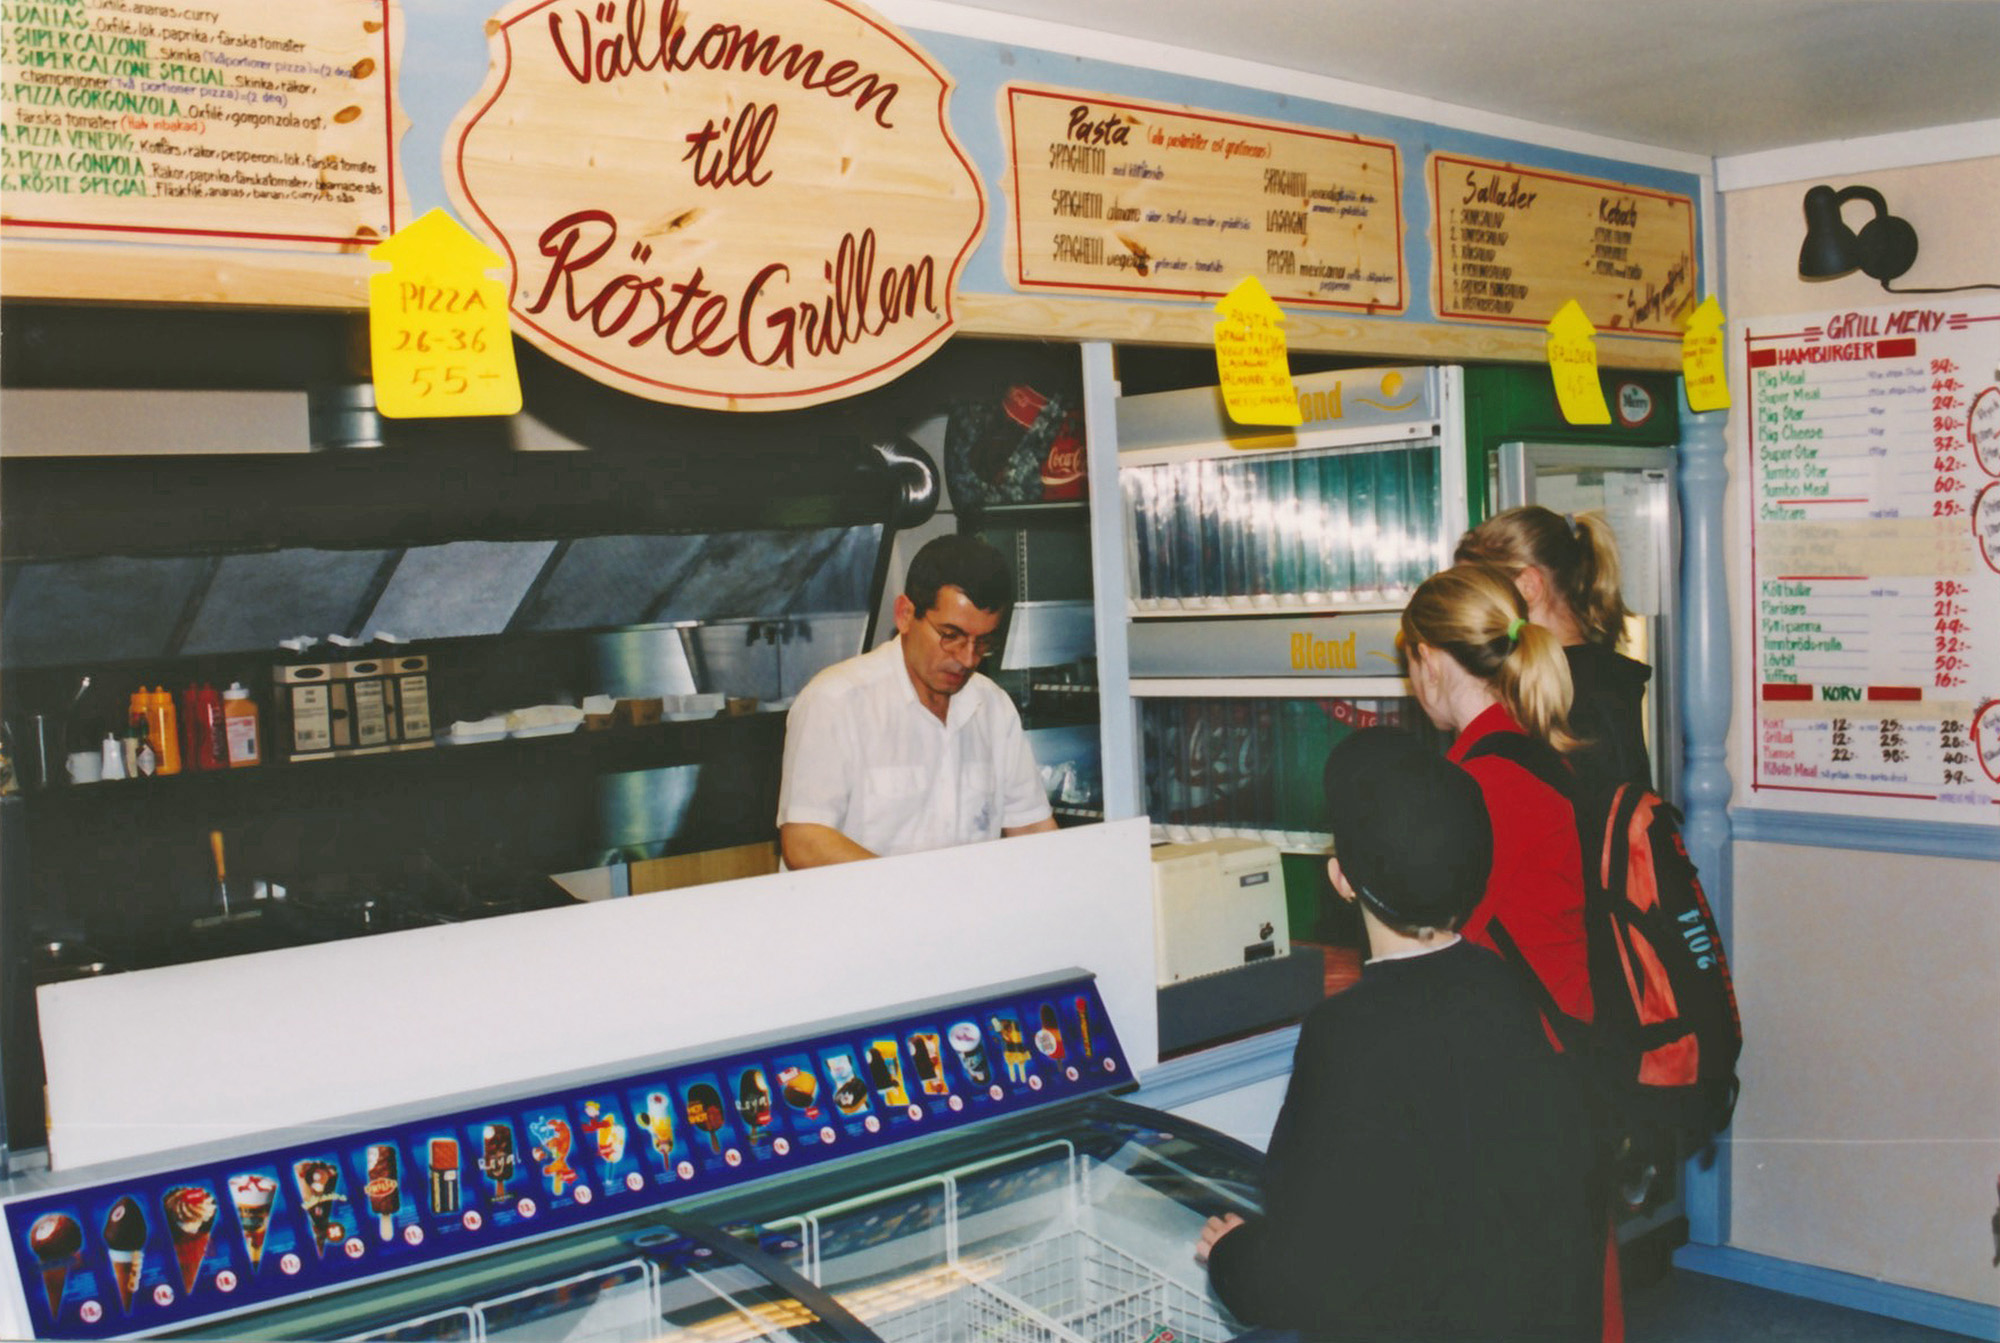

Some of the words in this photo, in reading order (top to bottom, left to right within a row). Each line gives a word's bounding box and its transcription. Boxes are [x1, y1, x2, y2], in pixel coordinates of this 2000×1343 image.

[16, 5, 89, 30] DALLAS
[73, 34, 150, 59] CALZONE
[77, 55, 153, 79] CALZONE
[160, 62, 224, 87] SPECIAL
[549, 0, 899, 128] Välkommen
[14, 83, 65, 109] PIZZA
[67, 87, 182, 117] GORGONZOLA
[16, 125, 64, 147] PIZZA
[67, 128, 135, 152] VENEDIG
[1067, 105, 1131, 146] Pasta
[682, 103, 778, 189] till
[1049, 143, 1105, 175] SPAGHETTI
[18, 150, 64, 170] PIZZA
[68, 151, 145, 177] GONDOLA
[80, 176, 148, 197] SPECIAL
[1463, 170, 1537, 209] Sallader
[1051, 189, 1103, 219] SPAGHETTI
[1053, 234, 1104, 265] SPAGHETTI
[400, 282, 487, 314] PIZZA
[391, 326, 487, 354] 26-36
[1827, 312, 1881, 340] GRILL
[1884, 310, 1945, 335] MENY
[1777, 341, 1875, 366] HAMBURGER
[1934, 456, 1967, 473] 42:-
[1933, 500, 1966, 517] 25:-
[1291, 631, 1357, 670] Blend
[1934, 655, 1970, 671] 50:-
[1822, 686, 1862, 701] KORV
